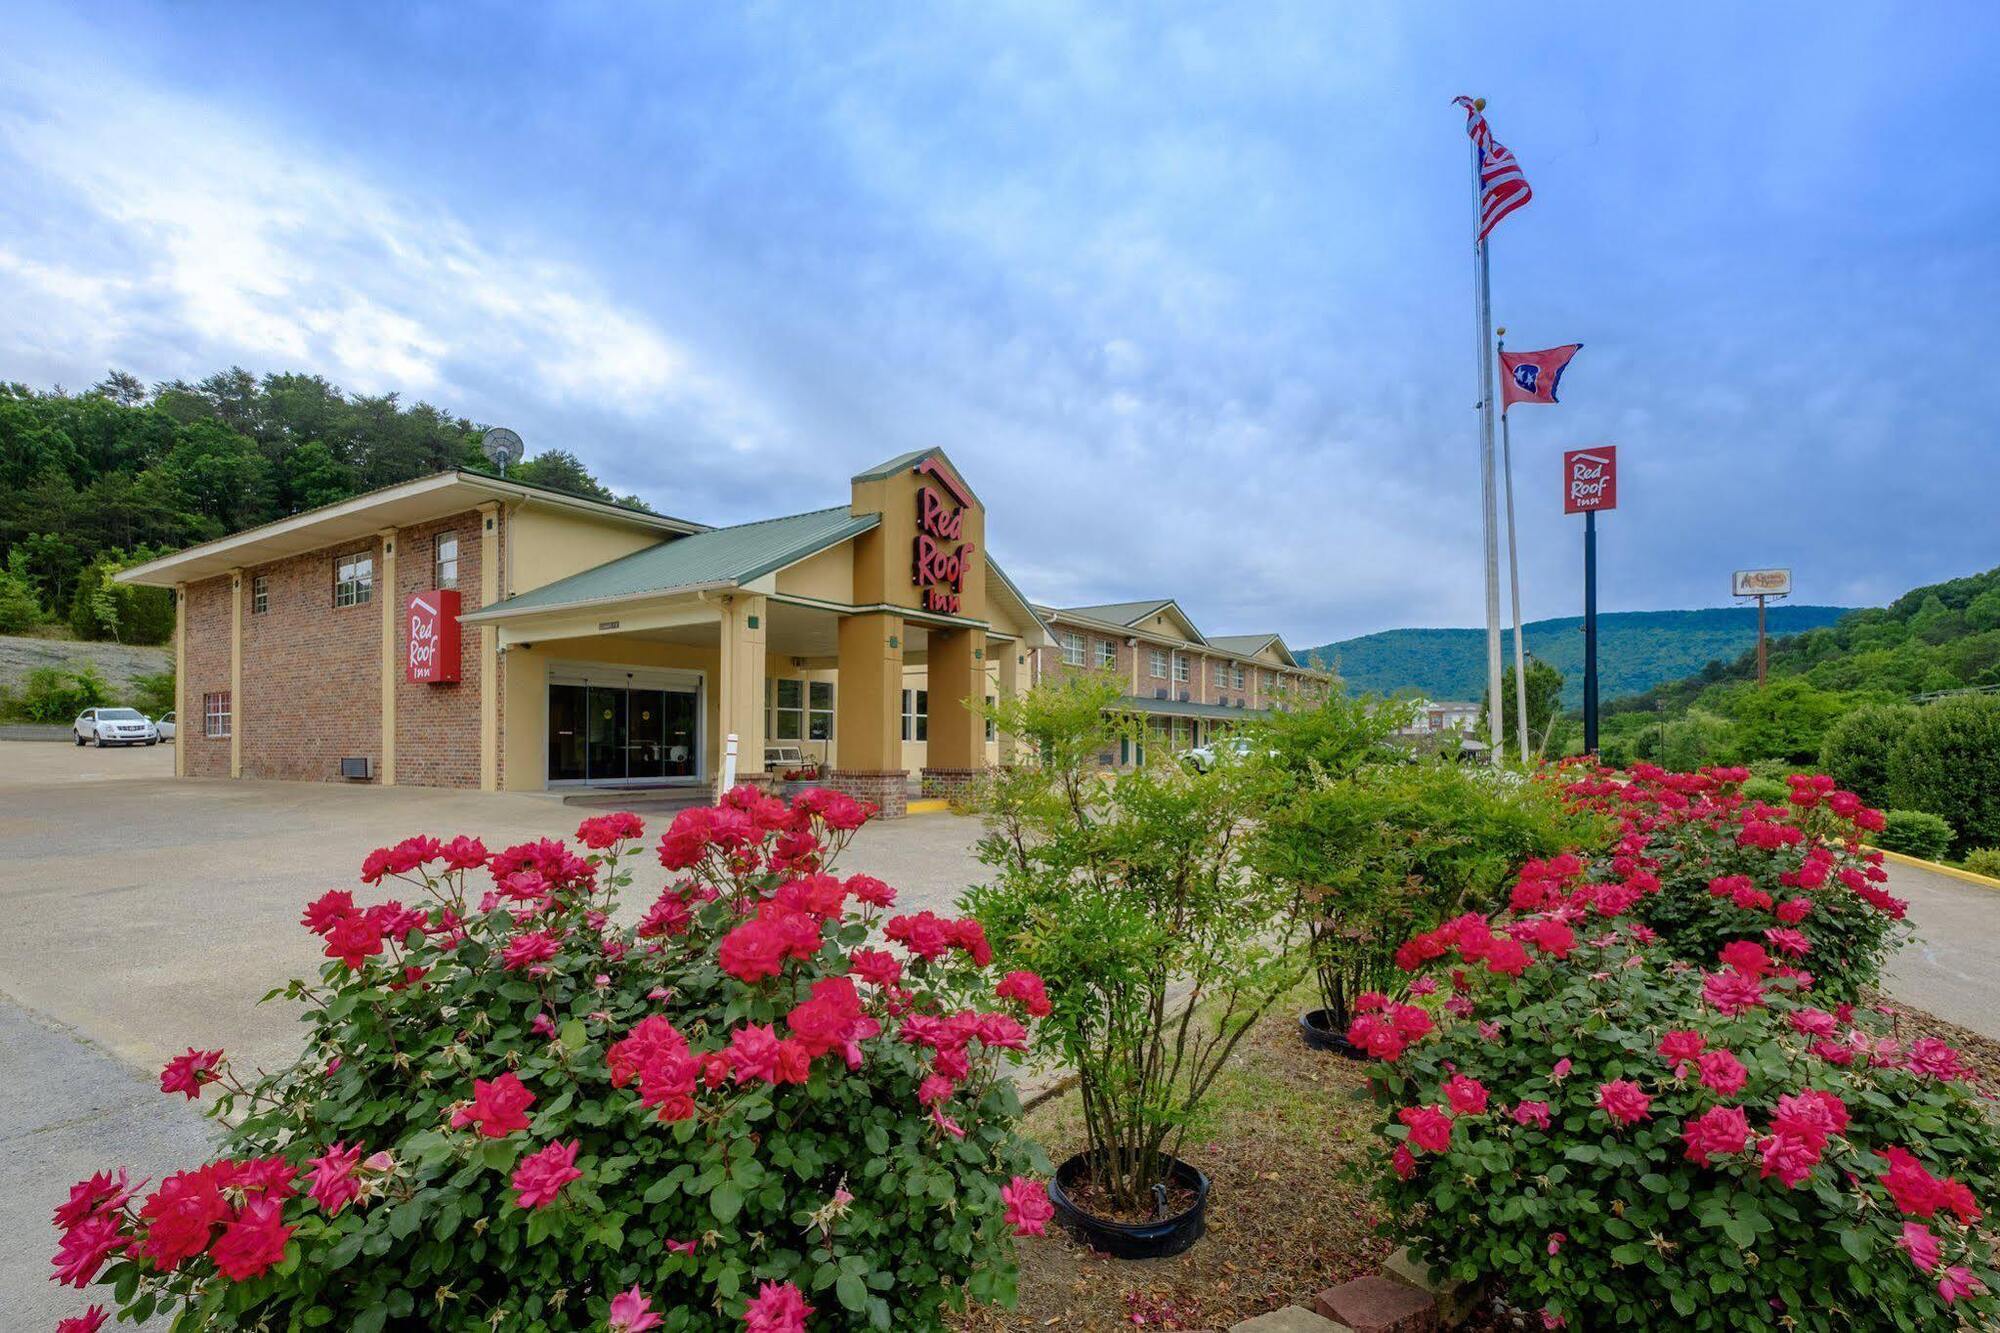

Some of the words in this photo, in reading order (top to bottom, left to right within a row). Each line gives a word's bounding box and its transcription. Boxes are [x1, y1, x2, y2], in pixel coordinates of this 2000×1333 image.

[1574, 464, 1602, 480] Red
[1571, 476, 1610, 499] Roof
[922, 487, 963, 540] Red
[918, 534, 974, 593] Roof
[928, 589, 961, 613] Inn
[411, 615, 433, 641] Red
[410, 635, 438, 668] Roof
[413, 668, 431, 679] Inn
